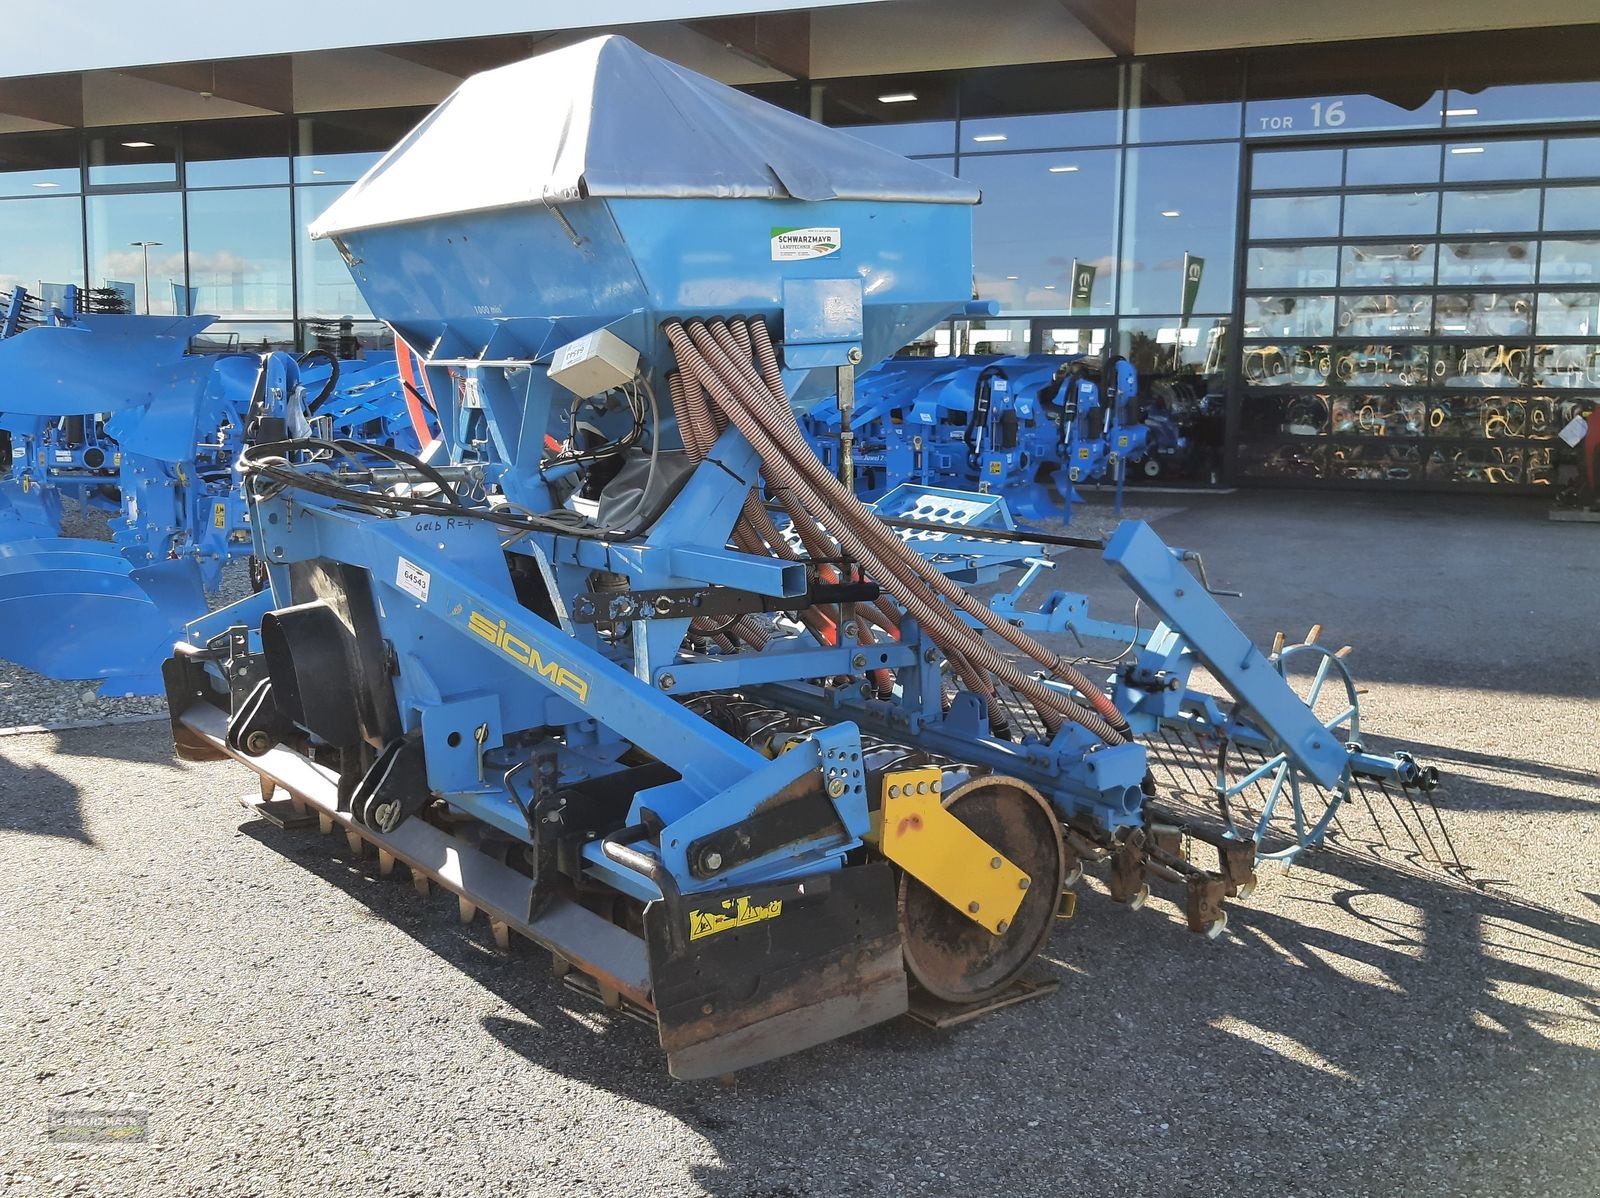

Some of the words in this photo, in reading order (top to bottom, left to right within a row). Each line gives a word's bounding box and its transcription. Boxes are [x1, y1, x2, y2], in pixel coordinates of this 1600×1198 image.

[1260, 116, 1293, 129] TOR
[1310, 101, 1346, 127] 16
[778, 235, 832, 243] SCHWARZMAYR
[404, 570, 426, 589] 64543
